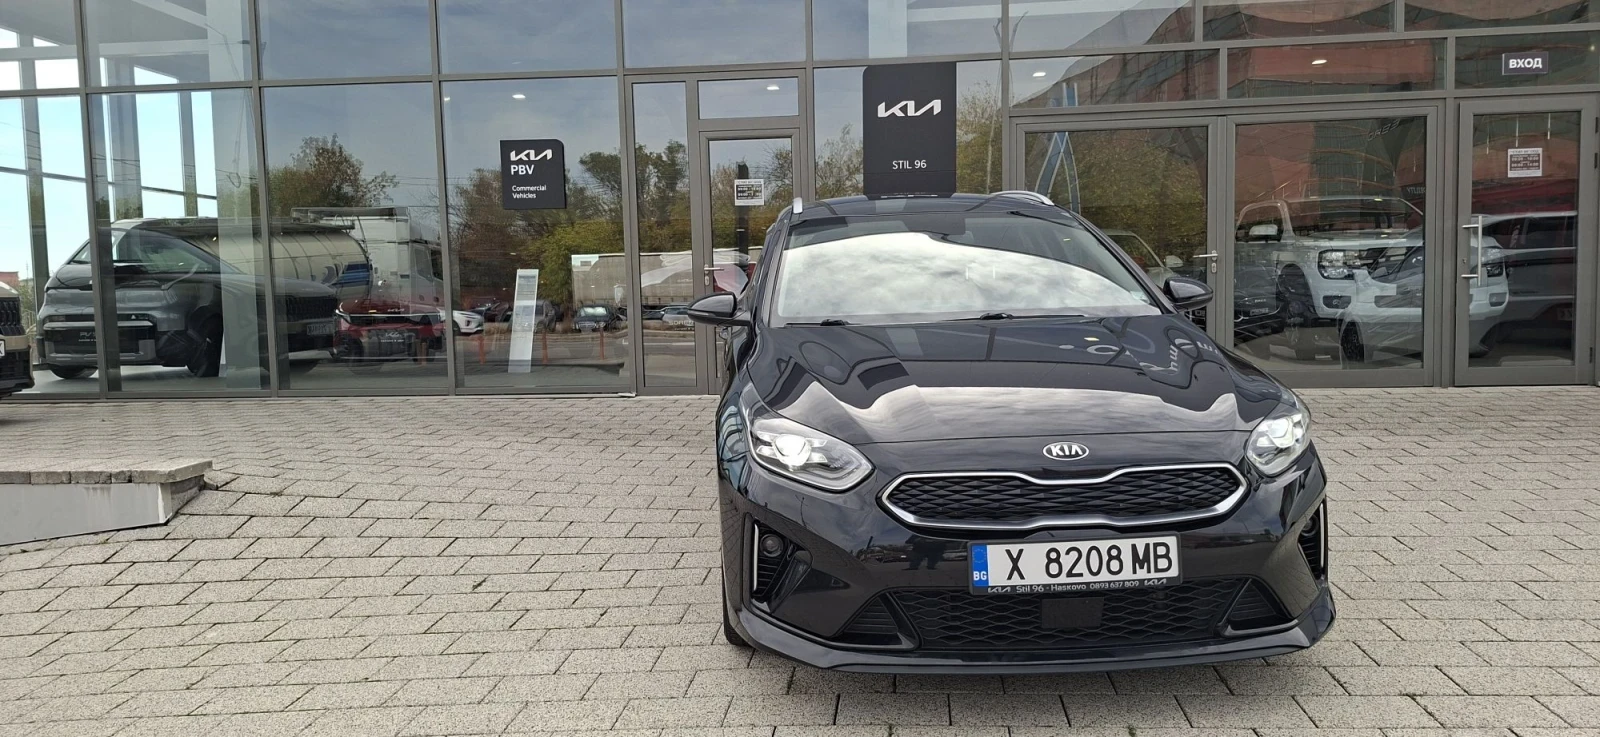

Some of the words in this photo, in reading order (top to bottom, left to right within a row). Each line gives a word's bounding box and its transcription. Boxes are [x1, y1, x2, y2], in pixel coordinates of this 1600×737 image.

[1509, 58, 1542, 69] ВХОД
[877, 99, 941, 118] KIA
[510, 149, 552, 161] KIA
[510, 164, 534, 175] PBV
[892, 160, 912, 170] STIL
[914, 159, 927, 169] 96
[1050, 444, 1083, 457] KIA
[1004, 548, 1026, 581] X
[1045, 544, 1124, 579] 8208
[1131, 541, 1173, 575] MB
[973, 571, 987, 581] BG
[1016, 585, 1030, 593] Stil
[1031, 584, 1044, 593] 96
[1089, 582, 1109, 590] 0893
